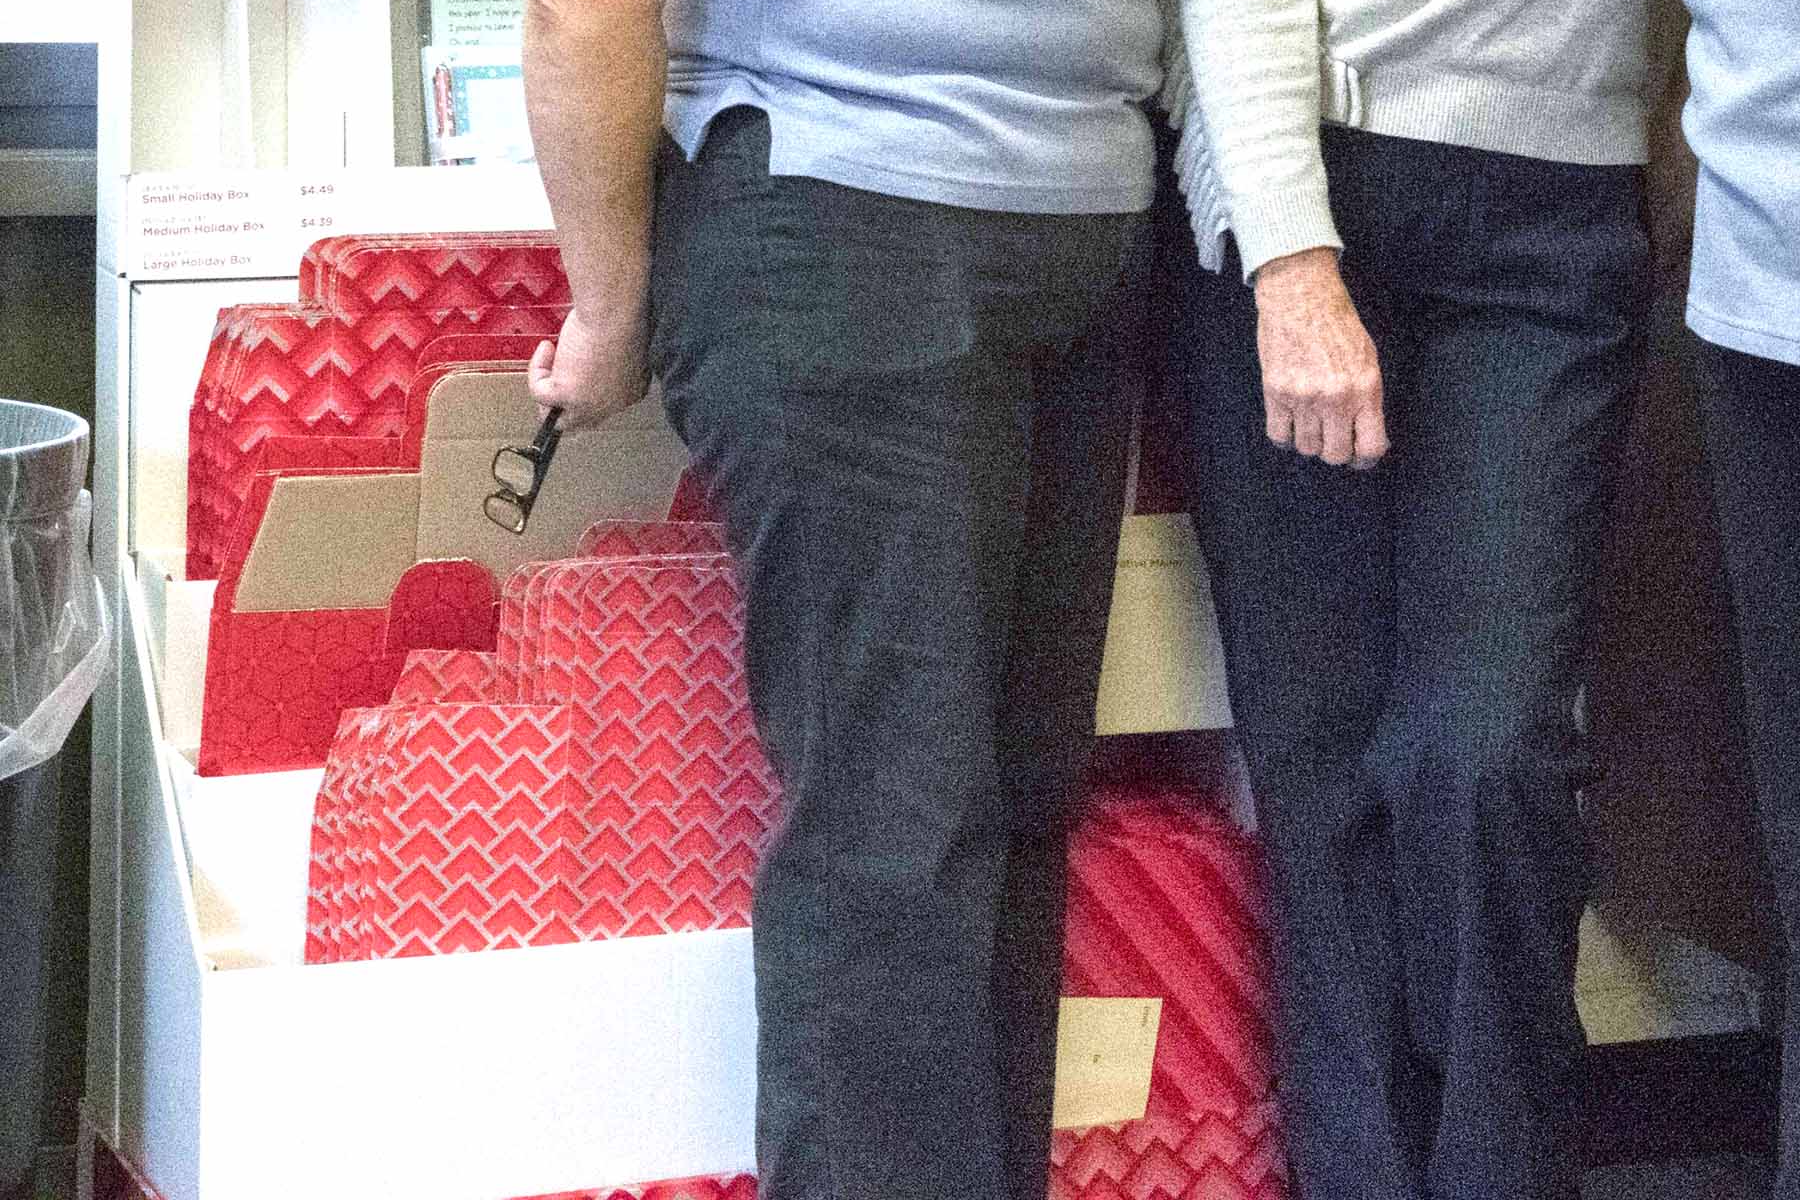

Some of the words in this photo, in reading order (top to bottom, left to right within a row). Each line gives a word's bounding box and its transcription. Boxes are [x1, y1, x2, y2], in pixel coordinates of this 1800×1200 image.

[142, 193, 175, 204] Small
[178, 191, 223, 203] Holiday
[227, 190, 250, 200] Box
[300, 184, 334, 196] $4.49
[143, 227, 190, 237] Medium
[194, 224, 240, 236] Holiday
[243, 222, 265, 231] Box
[143, 260, 177, 272] Large
[181, 257, 227, 269] Holiday
[230, 255, 251, 264] Box
